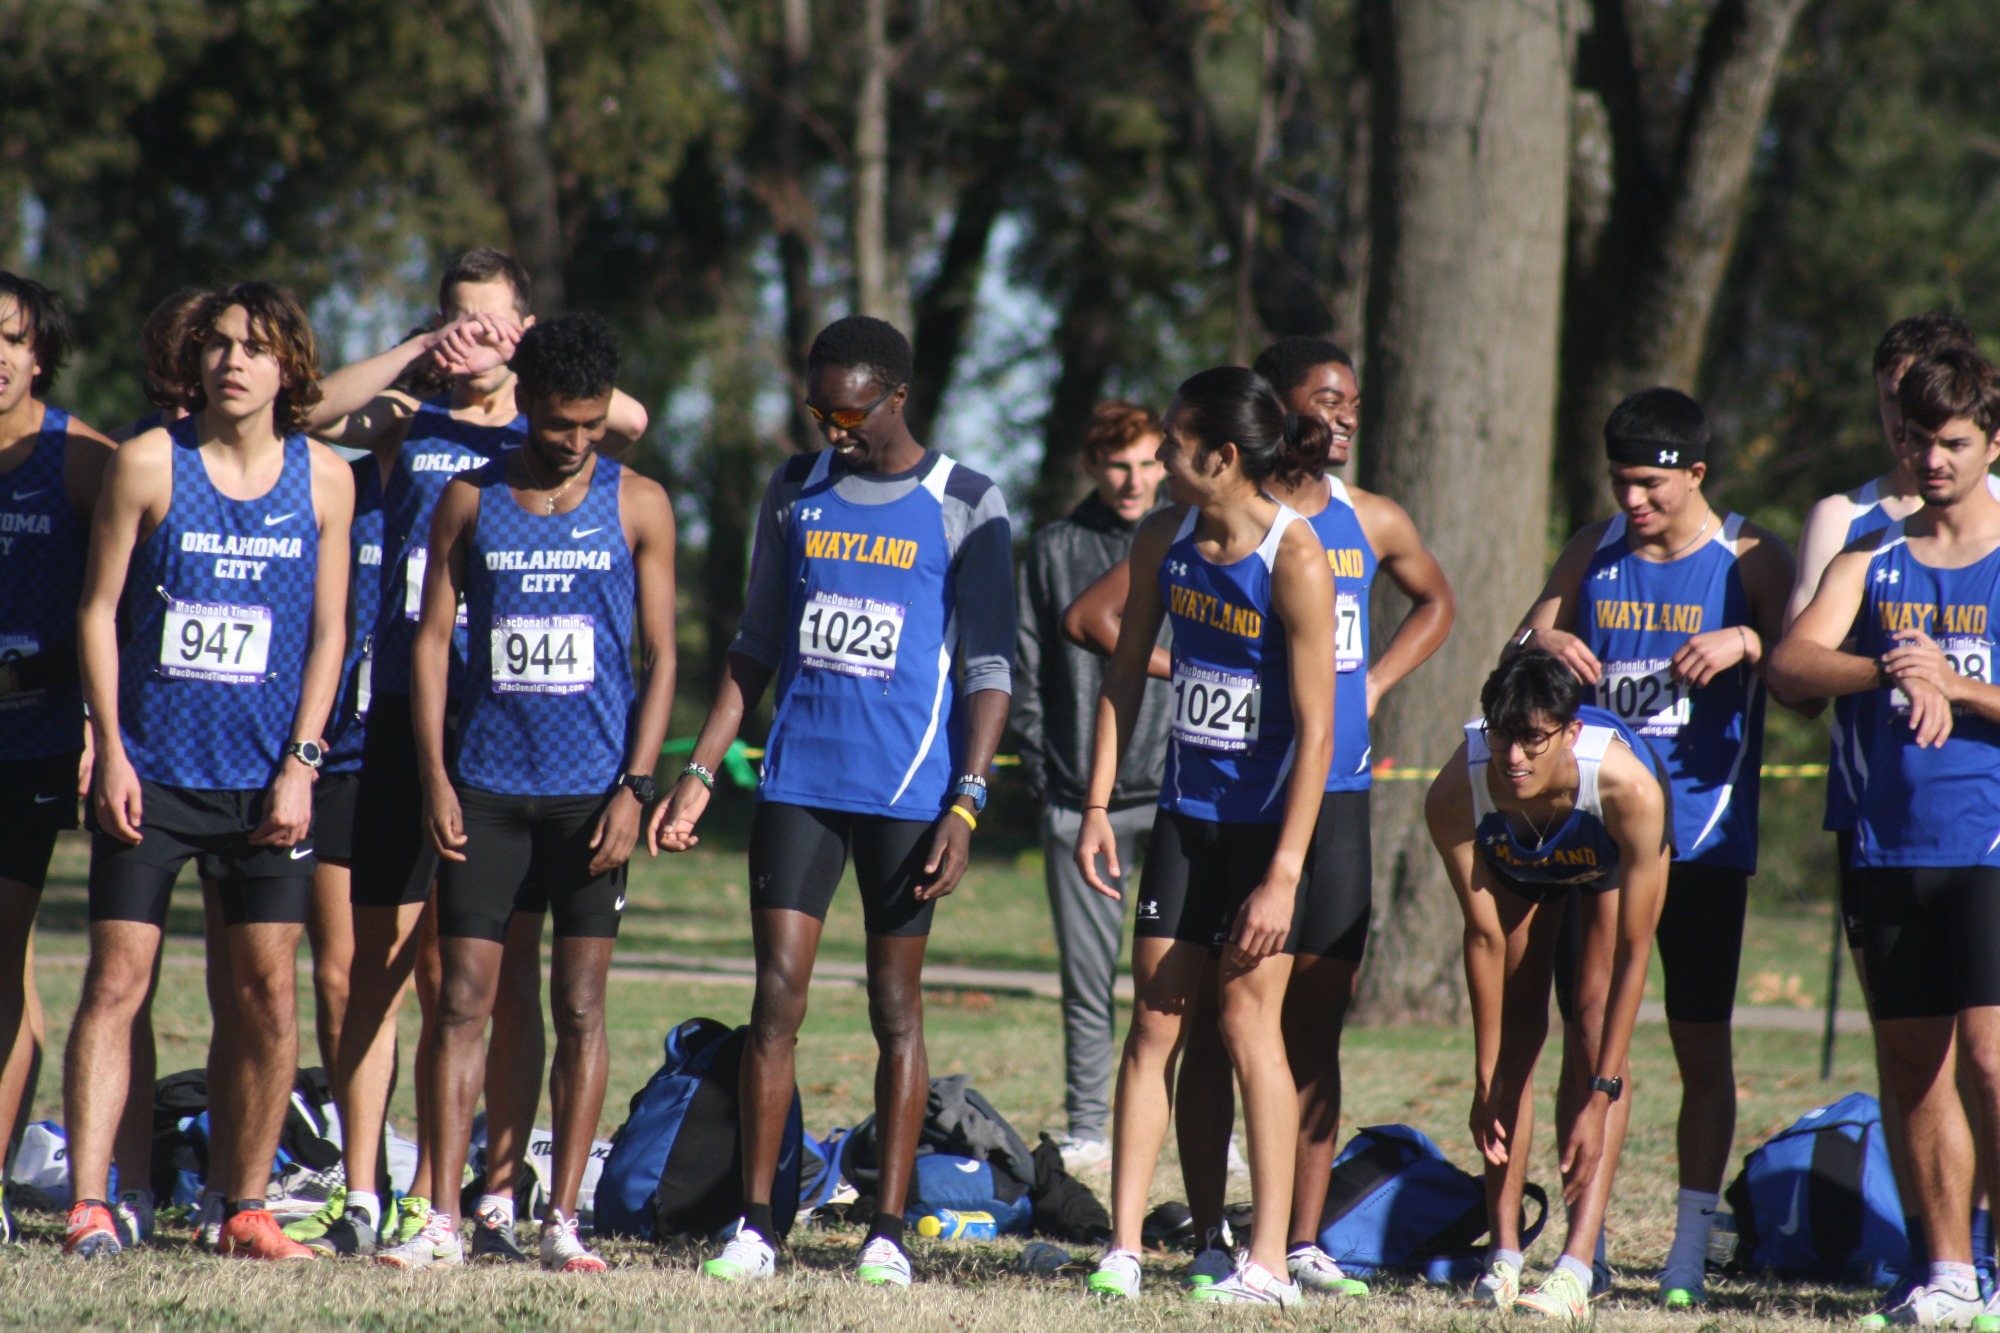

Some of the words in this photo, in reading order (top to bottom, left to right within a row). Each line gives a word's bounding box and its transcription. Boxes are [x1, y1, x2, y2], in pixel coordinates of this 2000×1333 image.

[0, 512, 51, 534] OMA
[181, 532, 302, 558] OKLAHOMA
[805, 530, 918, 570] WAYLAND
[214, 558, 267, 581] CITY
[485, 550, 611, 571] OKLAHOMA
[521, 573, 576, 592] CITY
[175, 601, 228, 617] MacDonald
[231, 606, 264, 621] Timing
[815, 591, 864, 609] MacDonald
[865, 599, 897, 616] Timing
[1170, 584, 1261, 638] WAYLAND
[500, 617, 550, 629] MacDonald
[1596, 600, 1703, 634] WAYLAND
[180, 619, 254, 665] 947
[808, 608, 896, 660] 1023
[506, 633, 578, 676] 944
[806, 656, 885, 678] MacDonaldTiming.com
[169, 667, 256, 684] MacDonaldTiming.com
[1179, 662, 1220, 683] MacDonald
[1222, 673, 1253, 689] Timing
[500, 682, 584, 695] MacDonaldTiming.com
[1599, 675, 1679, 718] 1021
[1175, 679, 1256, 733] 1024
